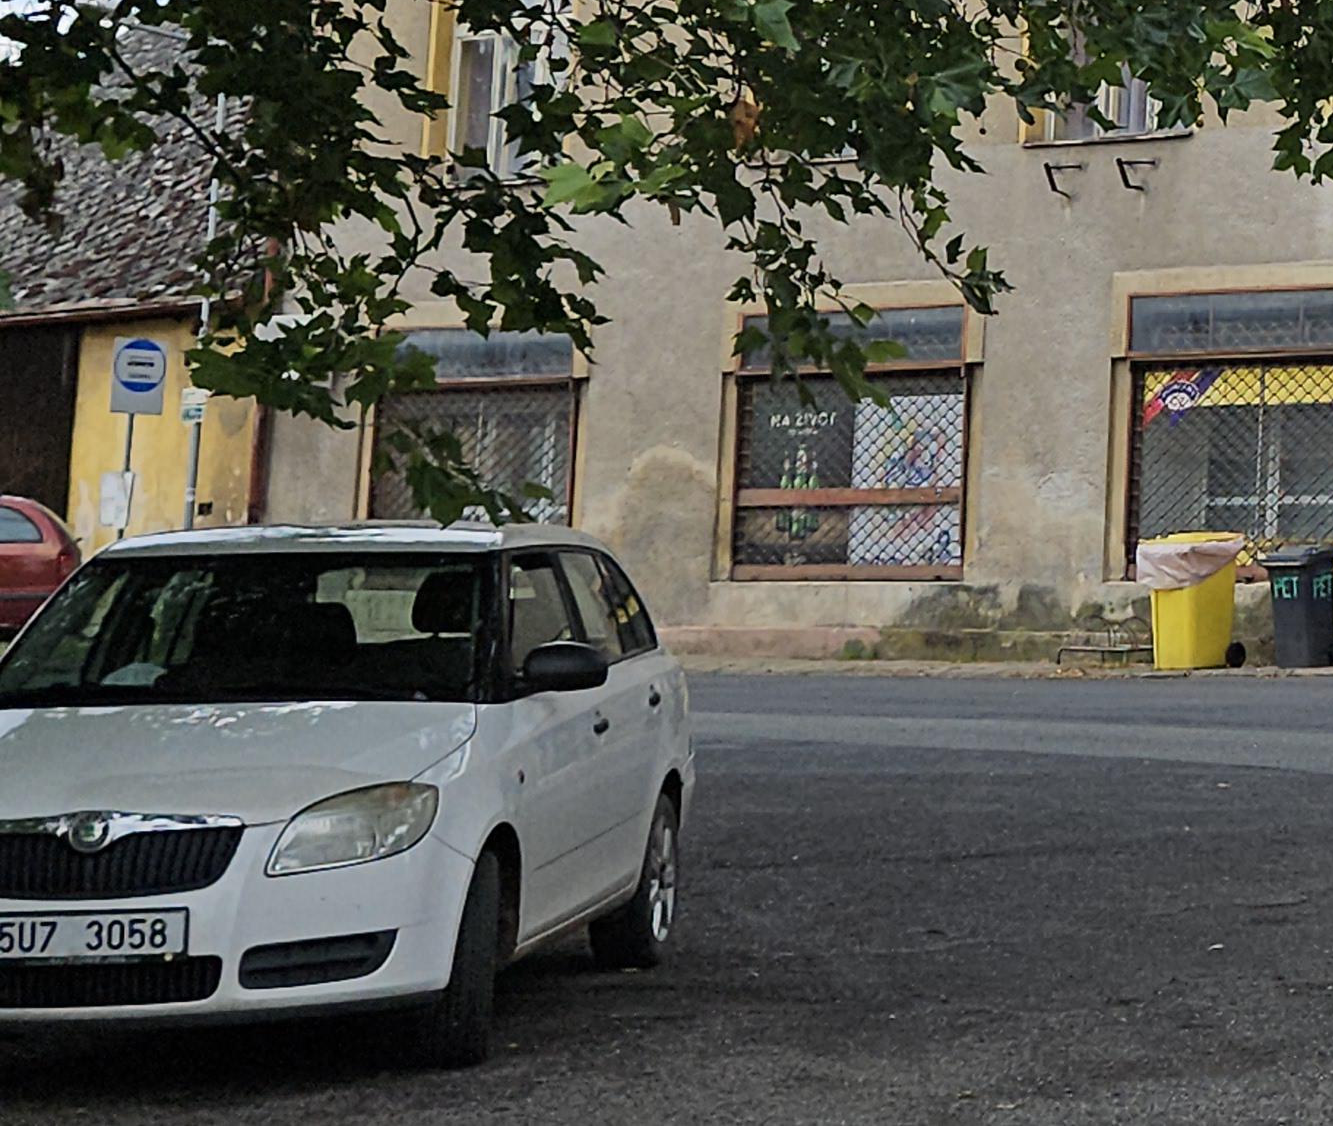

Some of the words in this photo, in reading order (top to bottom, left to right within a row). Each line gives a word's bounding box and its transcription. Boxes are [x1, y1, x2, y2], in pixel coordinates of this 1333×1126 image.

[1274, 576, 1299, 599] PET
[1313, 574, 1333, 600] PET
[0, 921, 57, 953] 5U7
[86, 918, 167, 950] 3058
